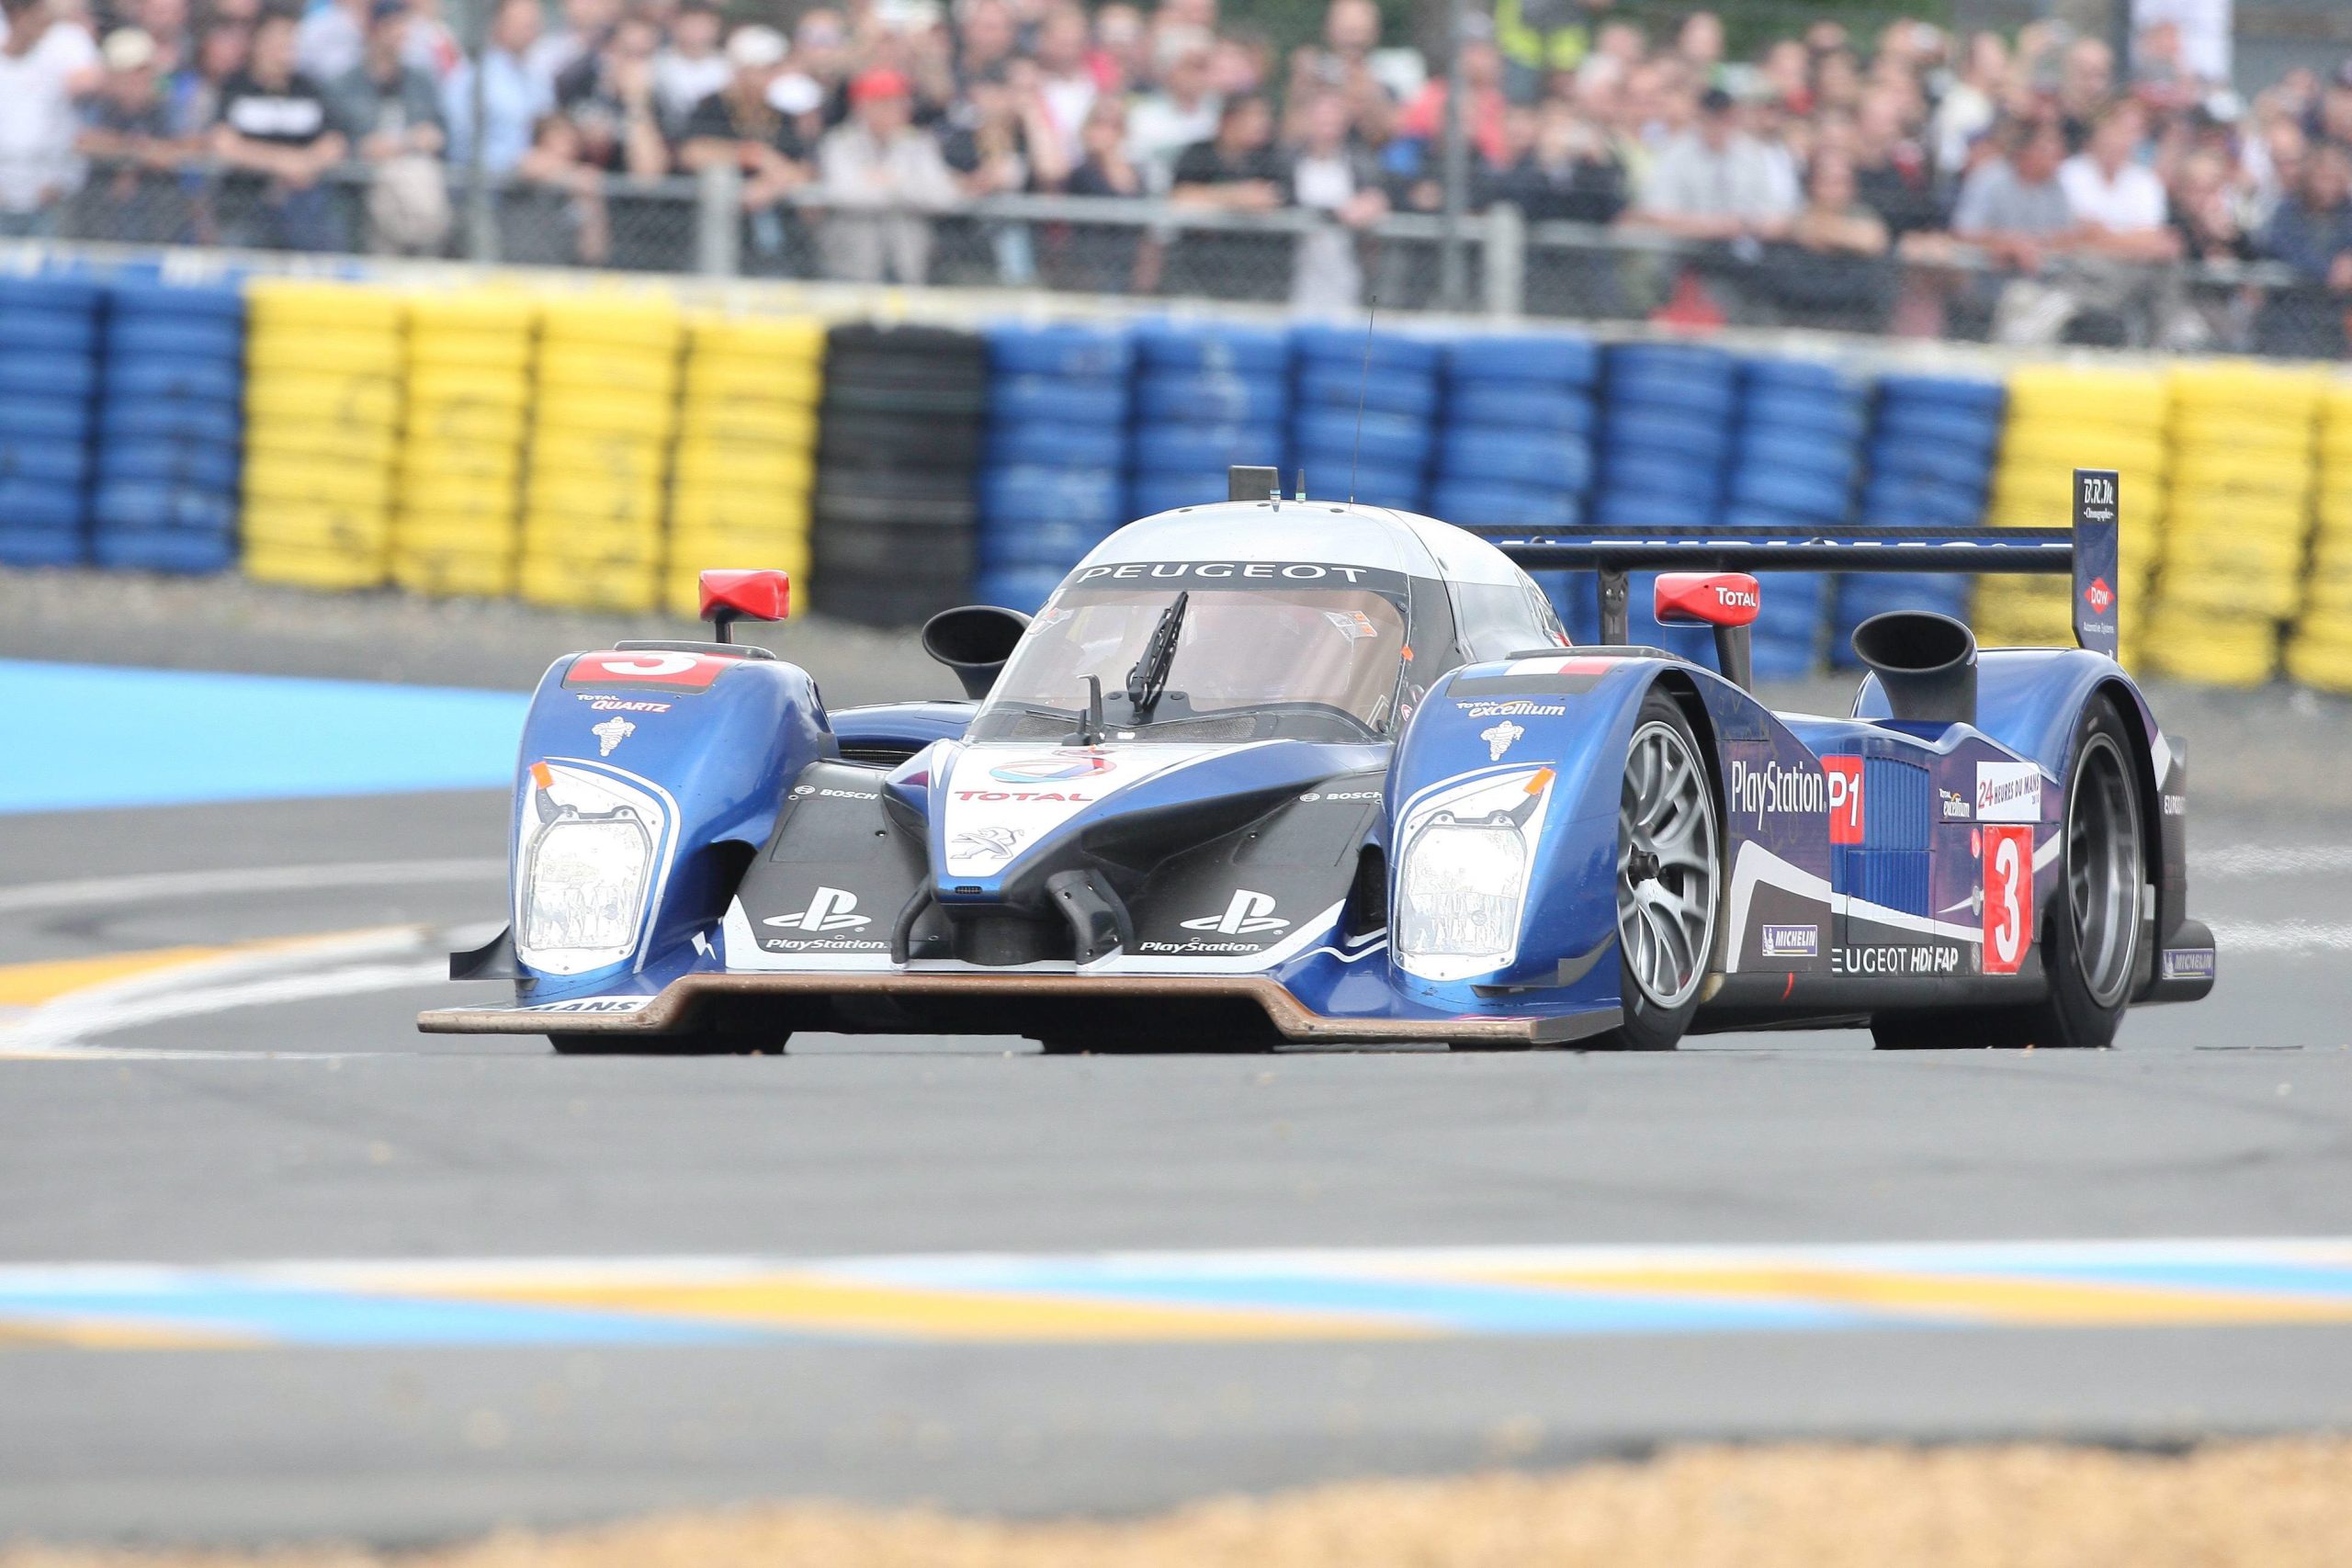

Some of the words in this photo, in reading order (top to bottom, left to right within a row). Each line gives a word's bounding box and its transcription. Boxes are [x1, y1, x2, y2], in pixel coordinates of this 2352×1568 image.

[1076, 563, 1367, 583] PEUGEOT
[1715, 586, 1757, 606] TOTAL
[591, 701, 672, 713] QUARTZ
[1456, 701, 1499, 709] TOTAL
[1468, 701, 1566, 718] excellium
[820, 788, 879, 800] BOSCH
[954, 791, 1093, 802] TOTAL
[1732, 761, 1824, 831] PlayStation
[1978, 779, 1994, 808] 24
[1994, 780, 2014, 805] HEURES
[2024, 773, 2040, 795] MANS
[1827, 772, 1860, 827] P1
[1995, 837, 2020, 963] 3
[766, 939, 886, 951] PlayStation
[1140, 941, 1261, 953] PlayStation
[1775, 930, 1816, 947] MICHELIN
[1831, 948, 1907, 973] EUGEOT
[1934, 946, 1959, 972] FAP
[2174, 953, 2212, 970] MICHELIN
[529, 1001, 638, 1011] ANS
